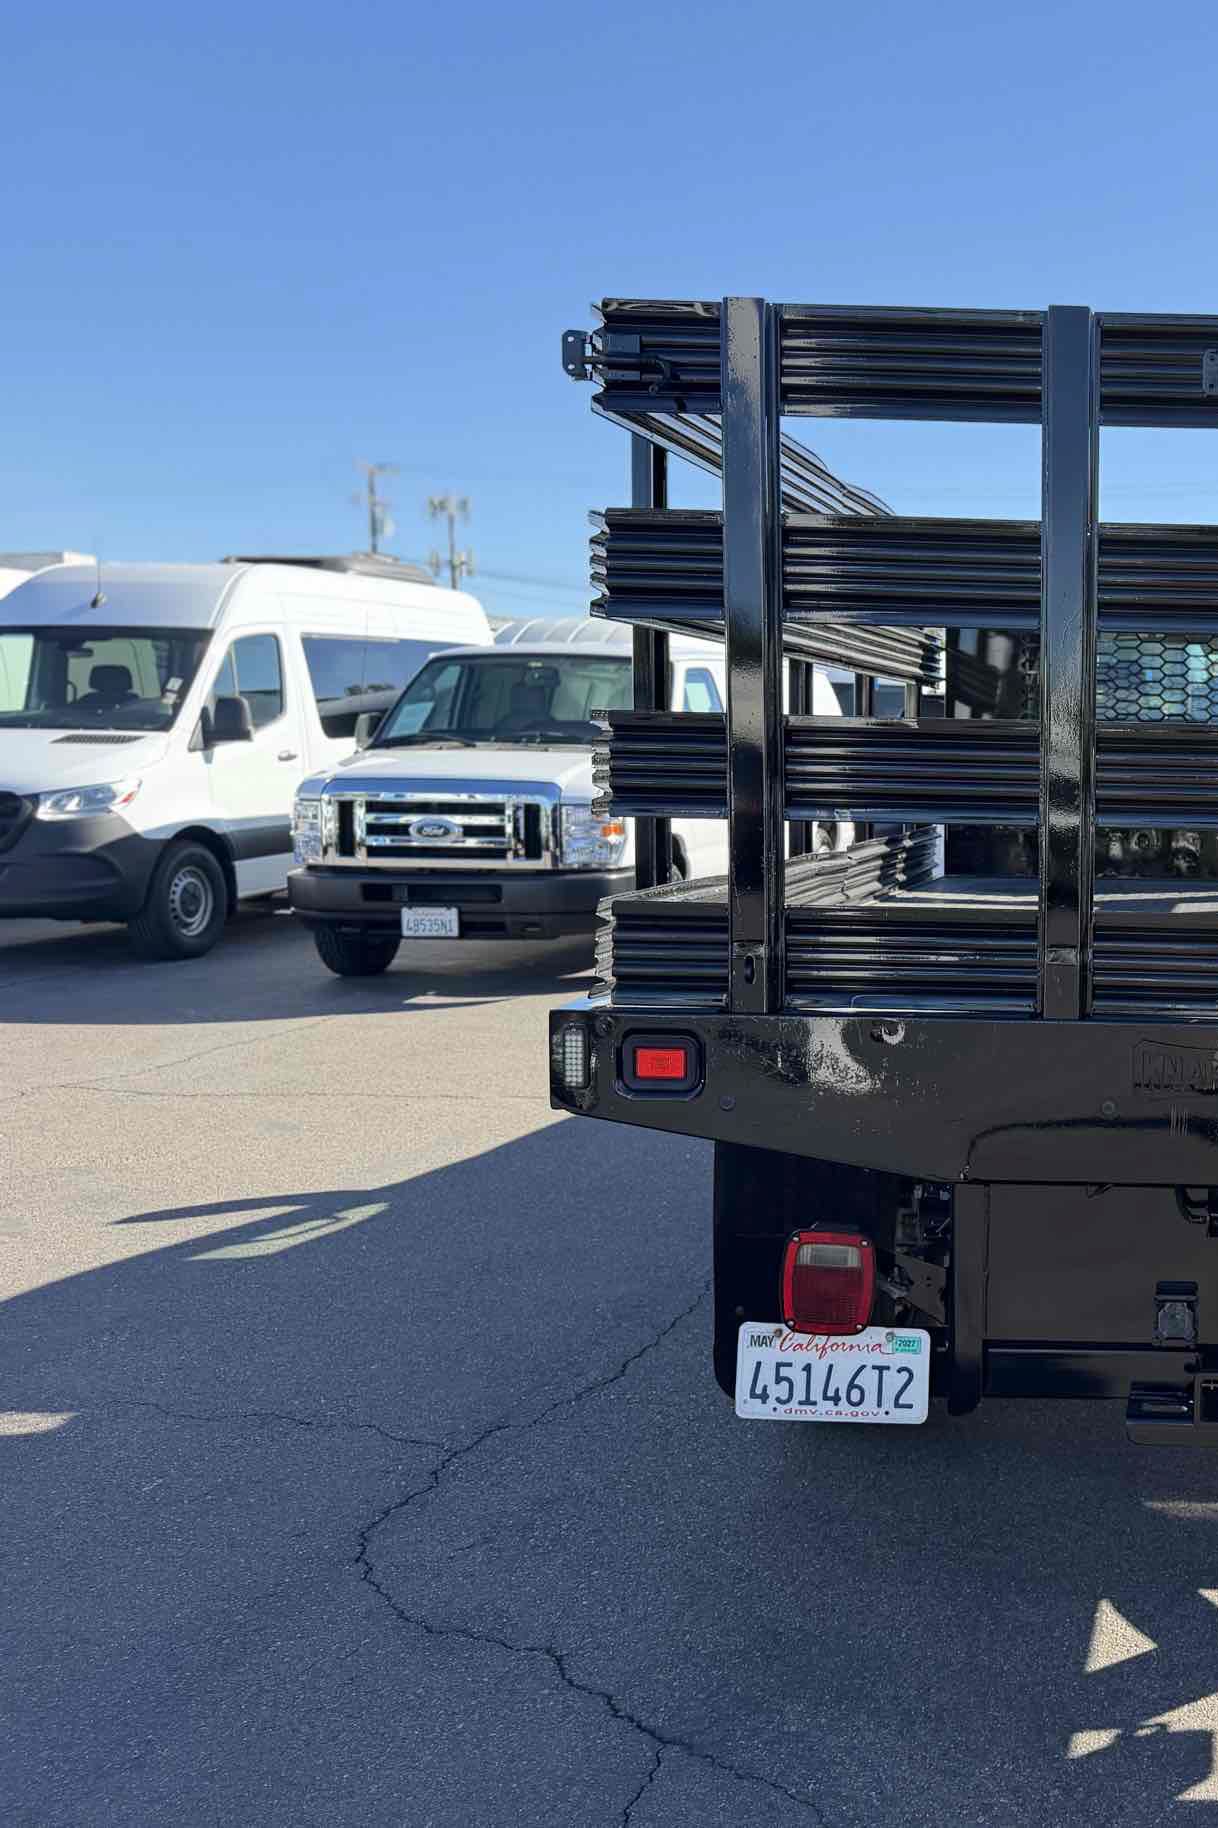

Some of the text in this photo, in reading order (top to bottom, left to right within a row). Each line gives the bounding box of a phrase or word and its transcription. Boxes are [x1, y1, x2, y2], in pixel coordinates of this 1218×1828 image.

[749, 1335, 775, 1348] MAY
[778, 1334, 884, 1360] California
[749, 1361, 915, 1409] 45146T2
[783, 1407, 881, 1417] dmv.ca.gov
